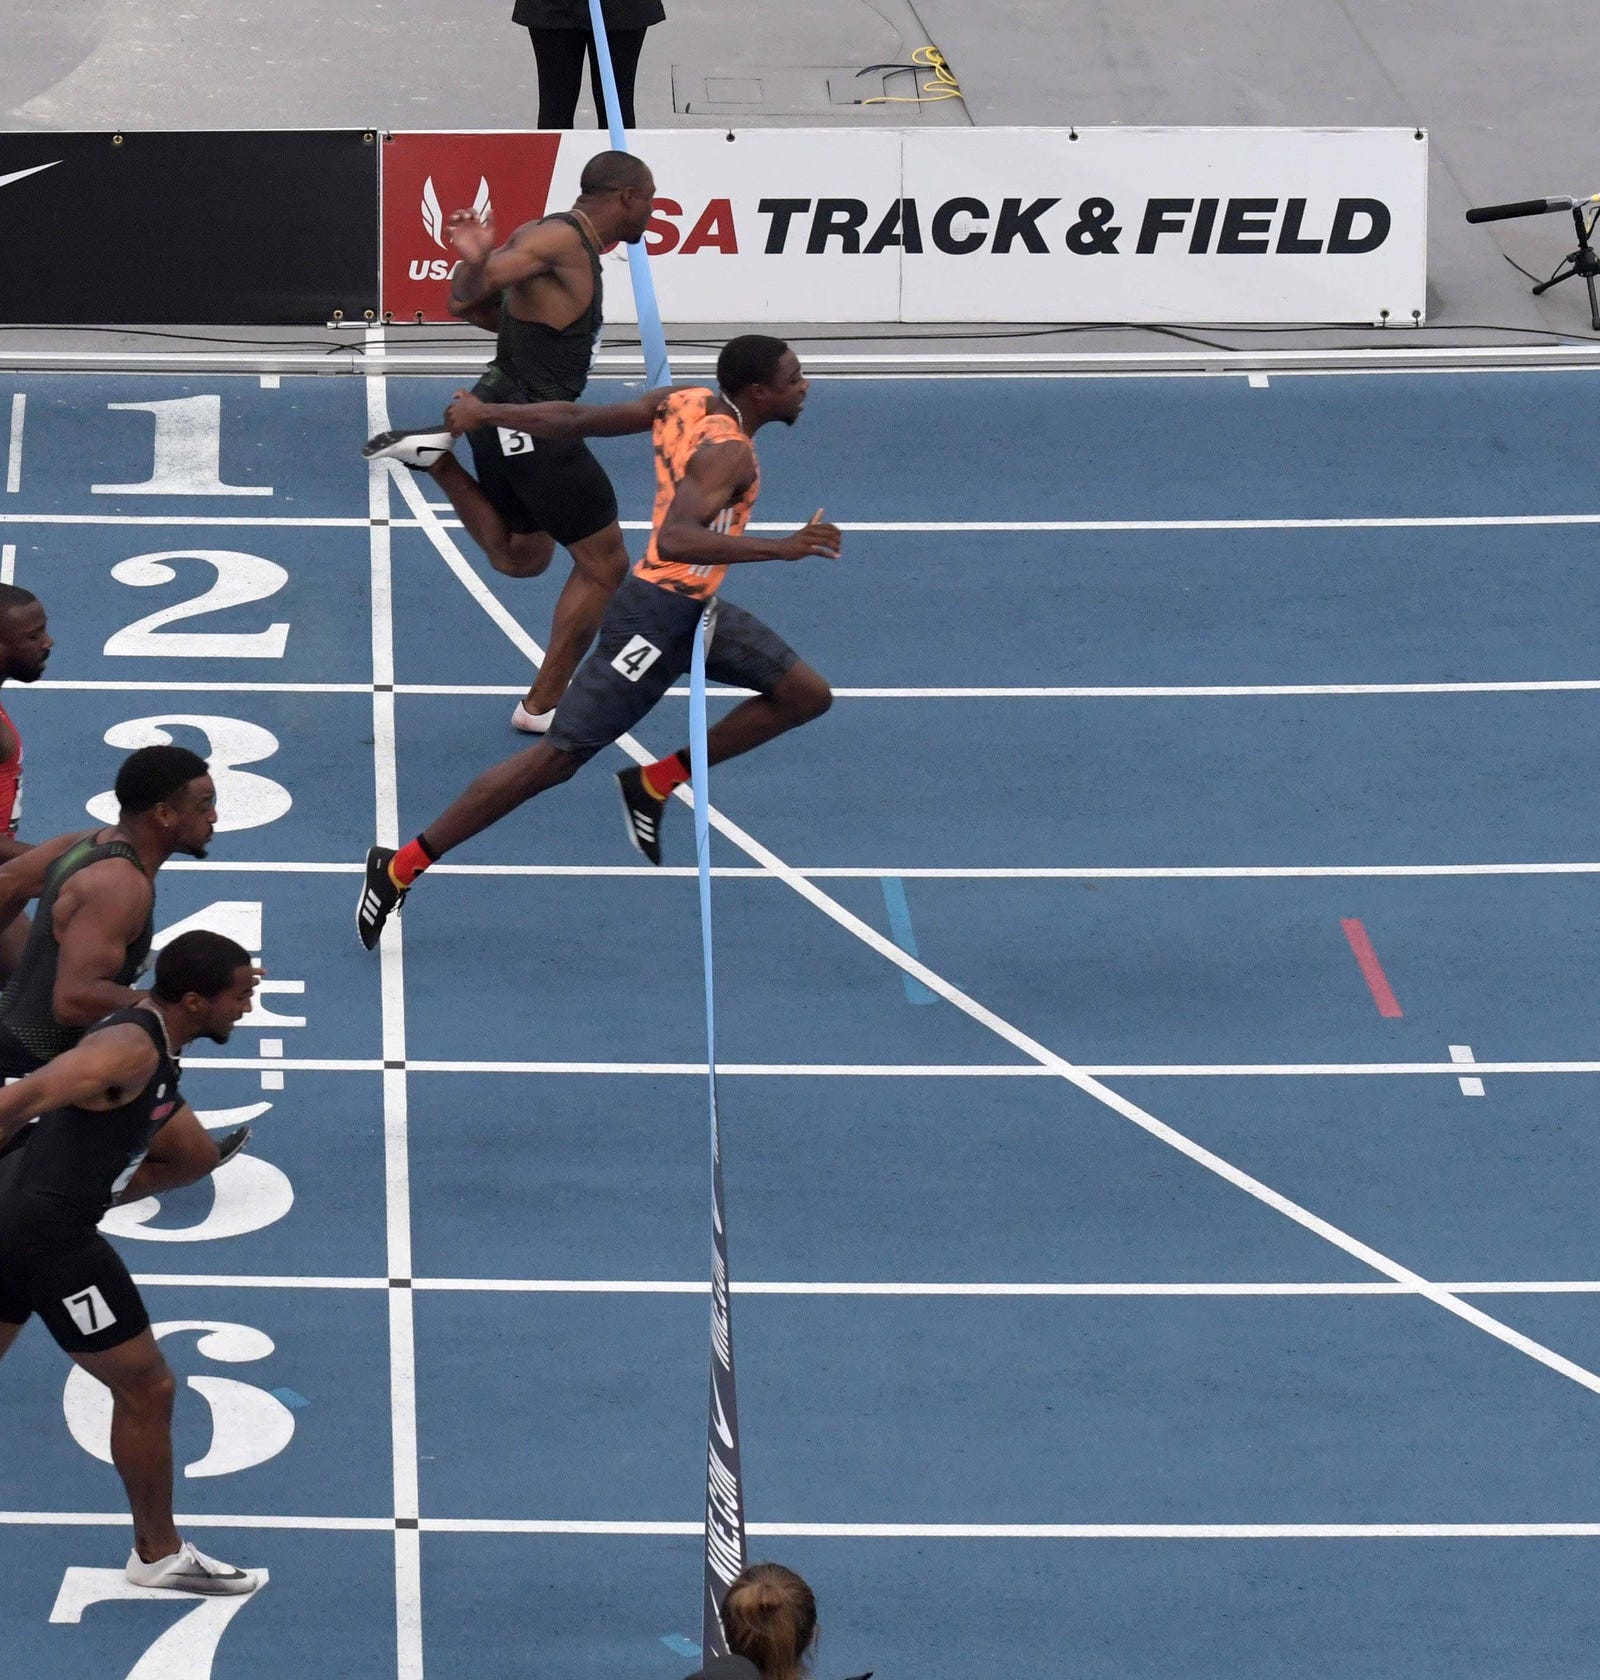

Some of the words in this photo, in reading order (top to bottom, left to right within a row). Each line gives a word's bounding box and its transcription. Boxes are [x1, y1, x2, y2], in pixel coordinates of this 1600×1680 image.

[600, 198, 738, 255] SA
[756, 197, 1062, 255] TRACK
[1135, 197, 1391, 255] FIELD
[90, 394, 274, 496] 1
[508, 430, 525, 453] 3
[103, 549, 291, 658] 2
[621, 645, 654, 676] 4
[85, 714, 293, 833] 3
[71, 1292, 98, 1331] 7
[64, 1319, 295, 1478] 6
[707, 1438, 743, 1588] NIKE.COM
[48, 1566, 270, 1680] 7
